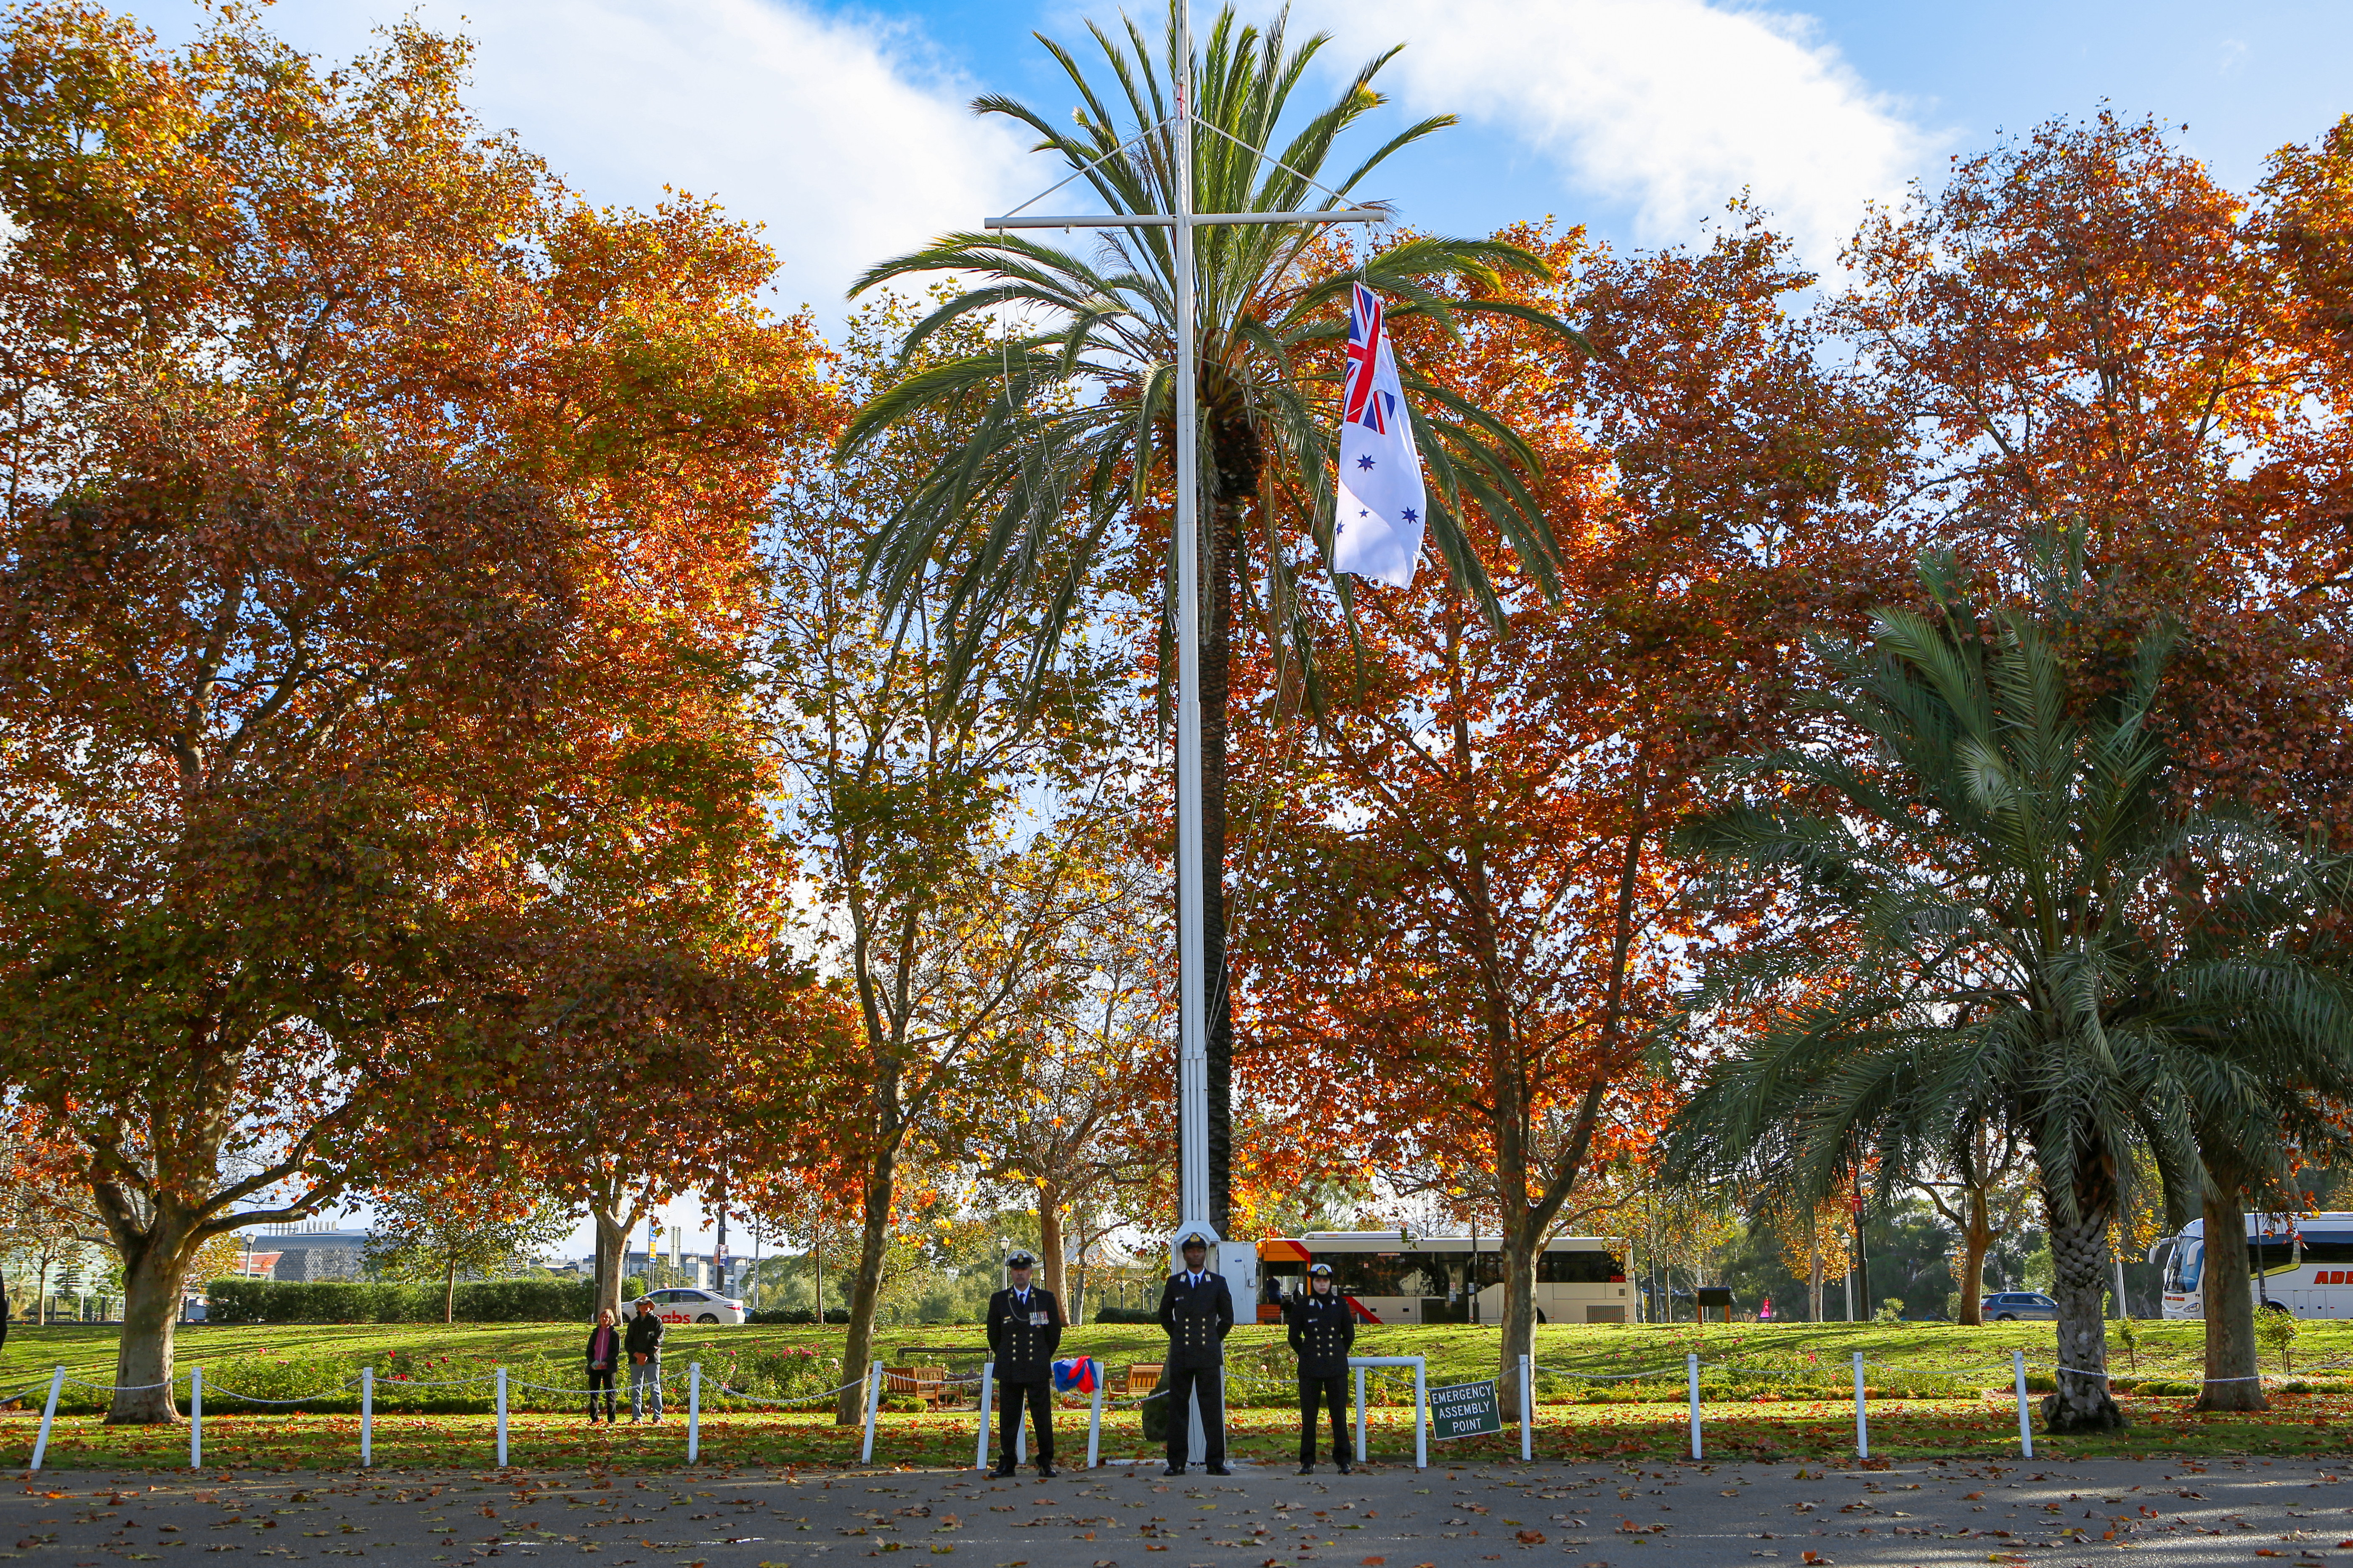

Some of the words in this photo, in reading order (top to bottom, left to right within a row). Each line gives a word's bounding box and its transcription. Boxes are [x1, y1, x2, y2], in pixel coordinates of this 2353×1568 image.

[1432, 1385, 1491, 1404] EMERGENCY
[1439, 1401, 1489, 1419] ASSEMBLY
[1453, 1418, 1481, 1433] POINT
